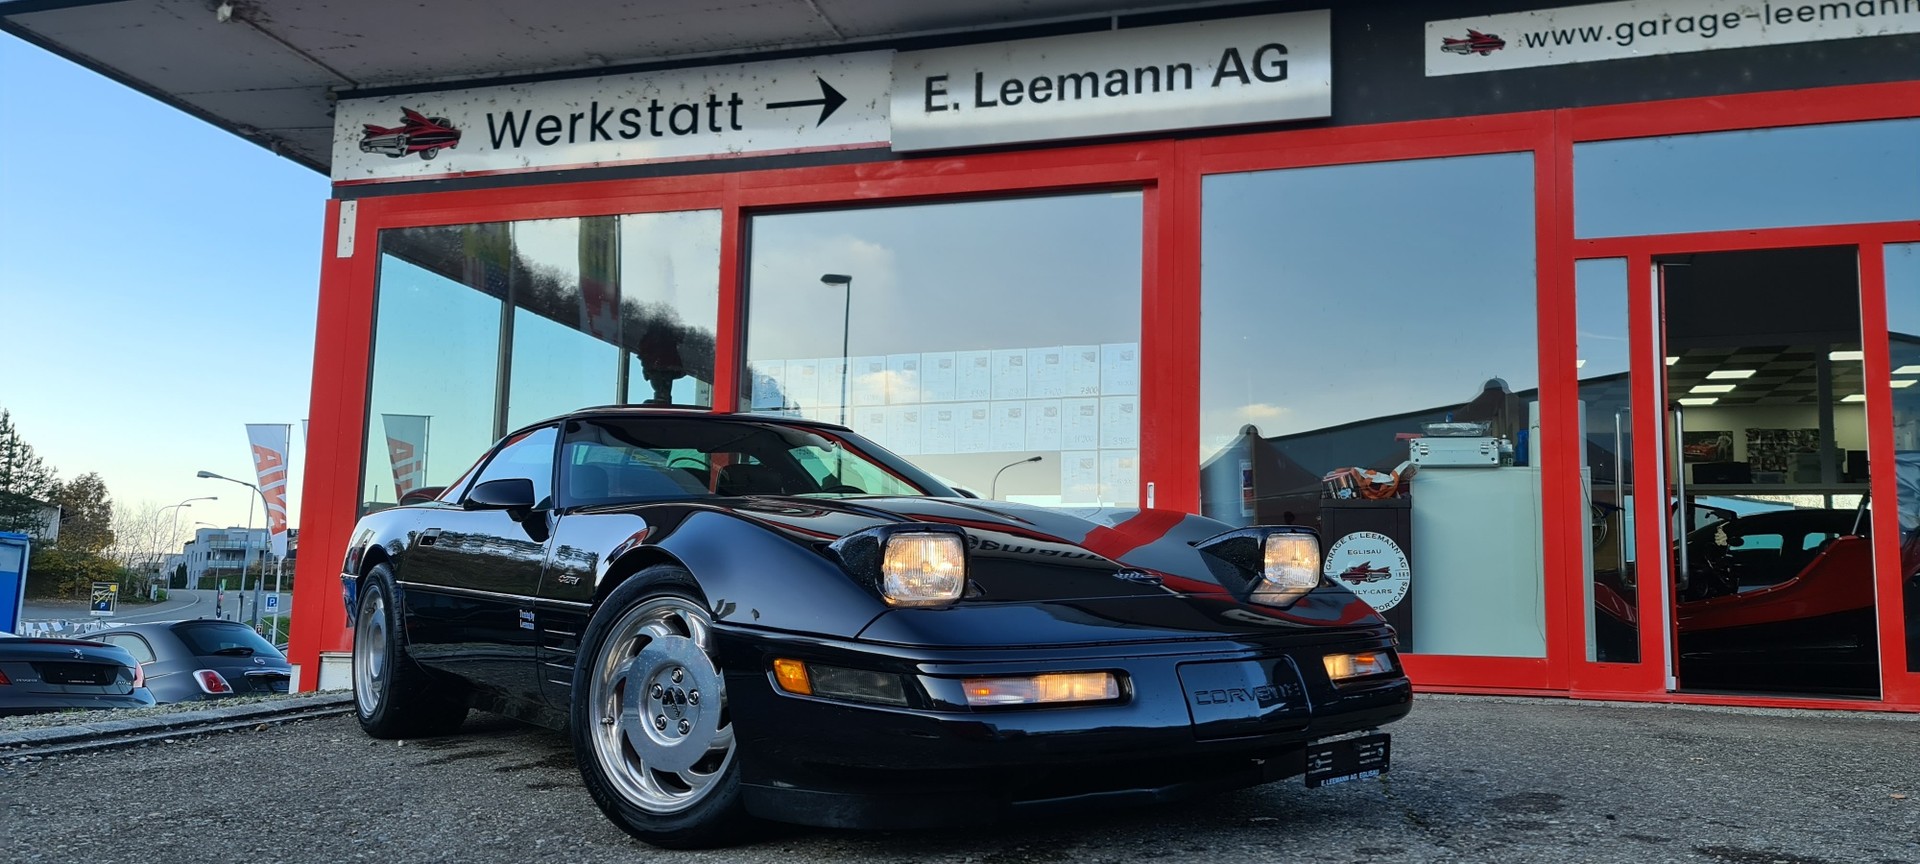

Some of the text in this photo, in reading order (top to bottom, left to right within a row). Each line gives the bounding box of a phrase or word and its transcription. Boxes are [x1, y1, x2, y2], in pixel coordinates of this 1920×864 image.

[924, 43, 1289, 113] E. Leemann AG
[486, 92, 744, 150] Werkstatt
[1325, 537, 1347, 570] GARAGE
[1359, 532, 1401, 554] LEEMANN
[1398, 556, 1407, 568] AG
[1373, 581, 1408, 611] PORTCARS
[1326, 775, 1350, 786] LEEMANN
